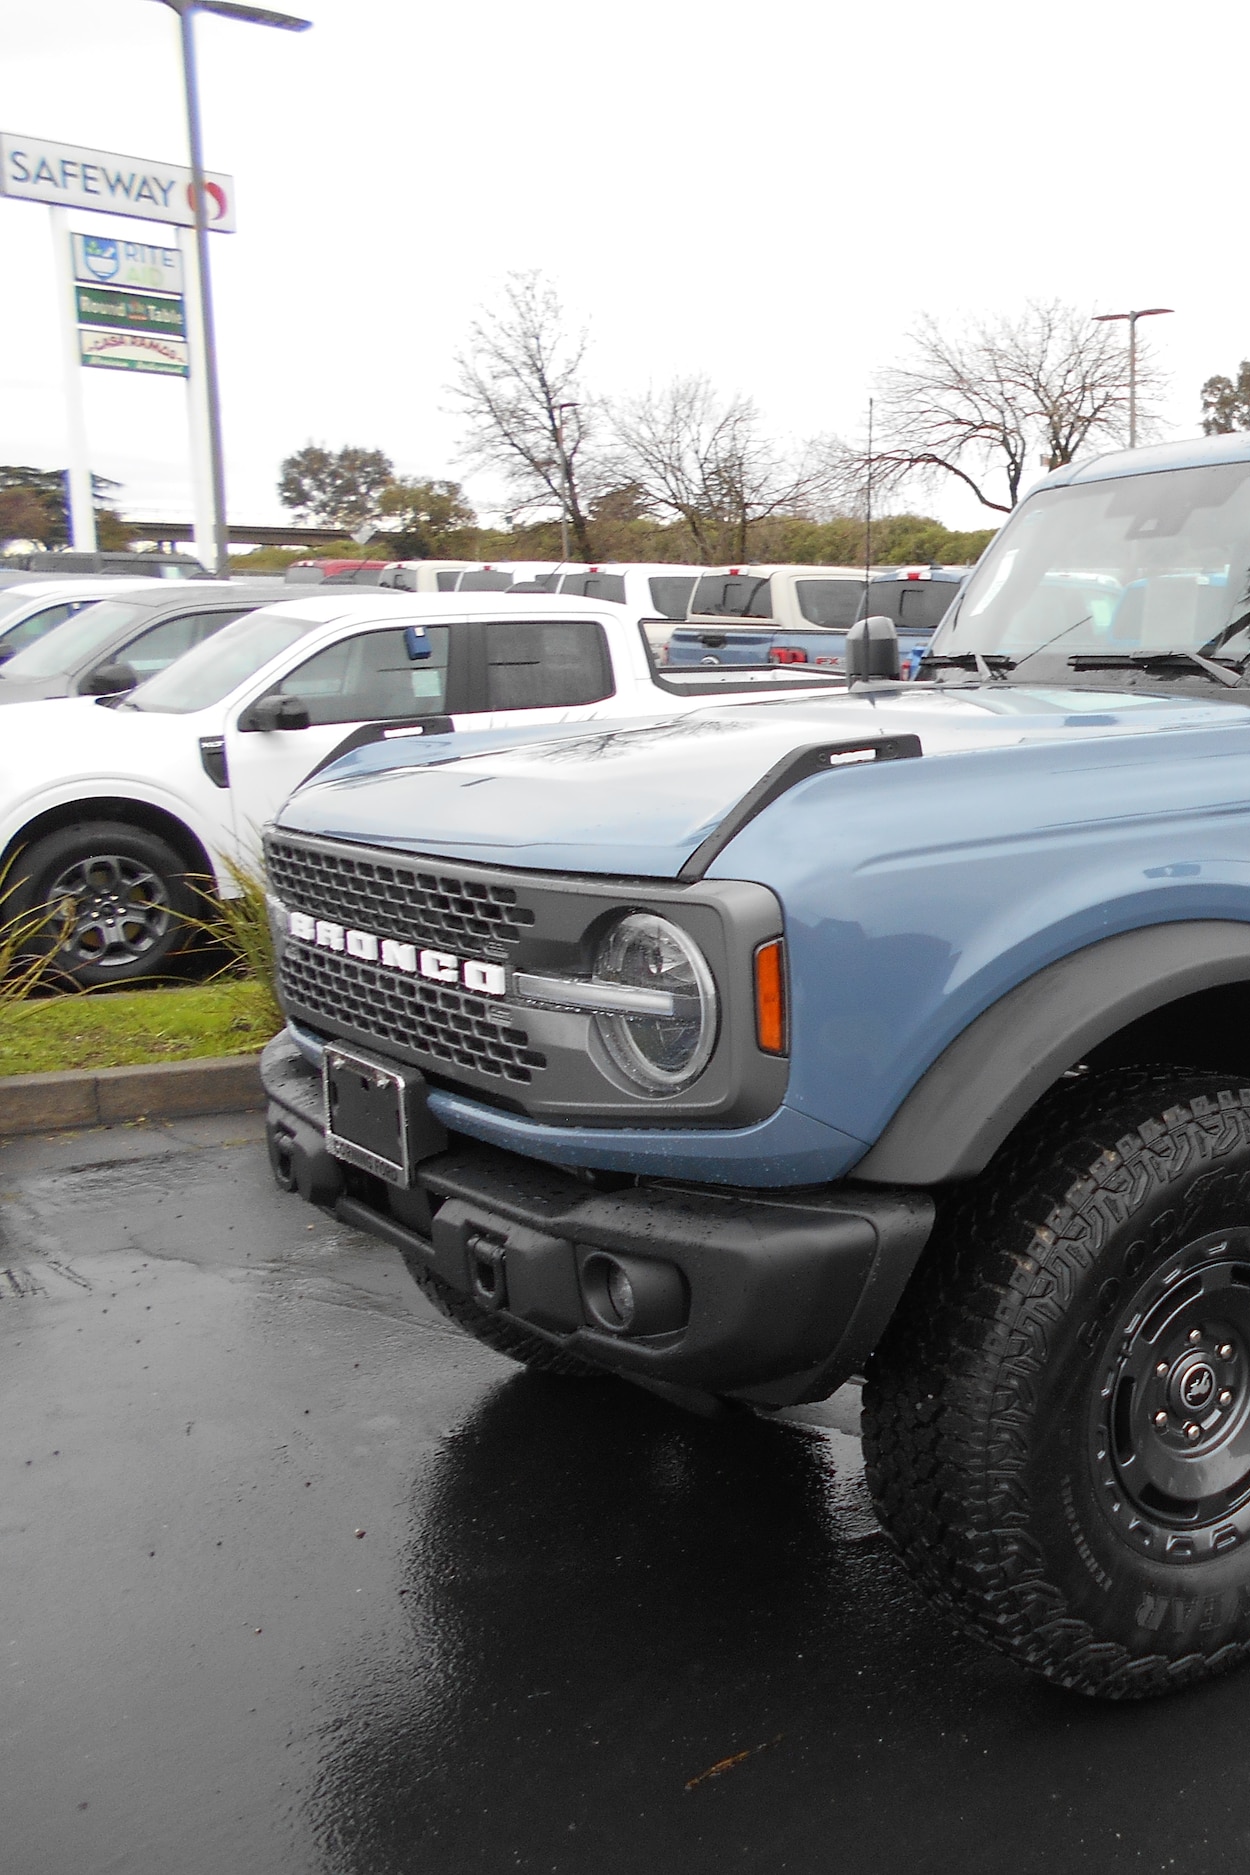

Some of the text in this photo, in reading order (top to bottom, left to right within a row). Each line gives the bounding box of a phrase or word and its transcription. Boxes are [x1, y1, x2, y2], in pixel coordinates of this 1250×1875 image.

[10, 150, 176, 208] SAFEWAY
[125, 241, 175, 268] RITE
[127, 266, 164, 287] AID
[290, 911, 506, 996] BRONCO
